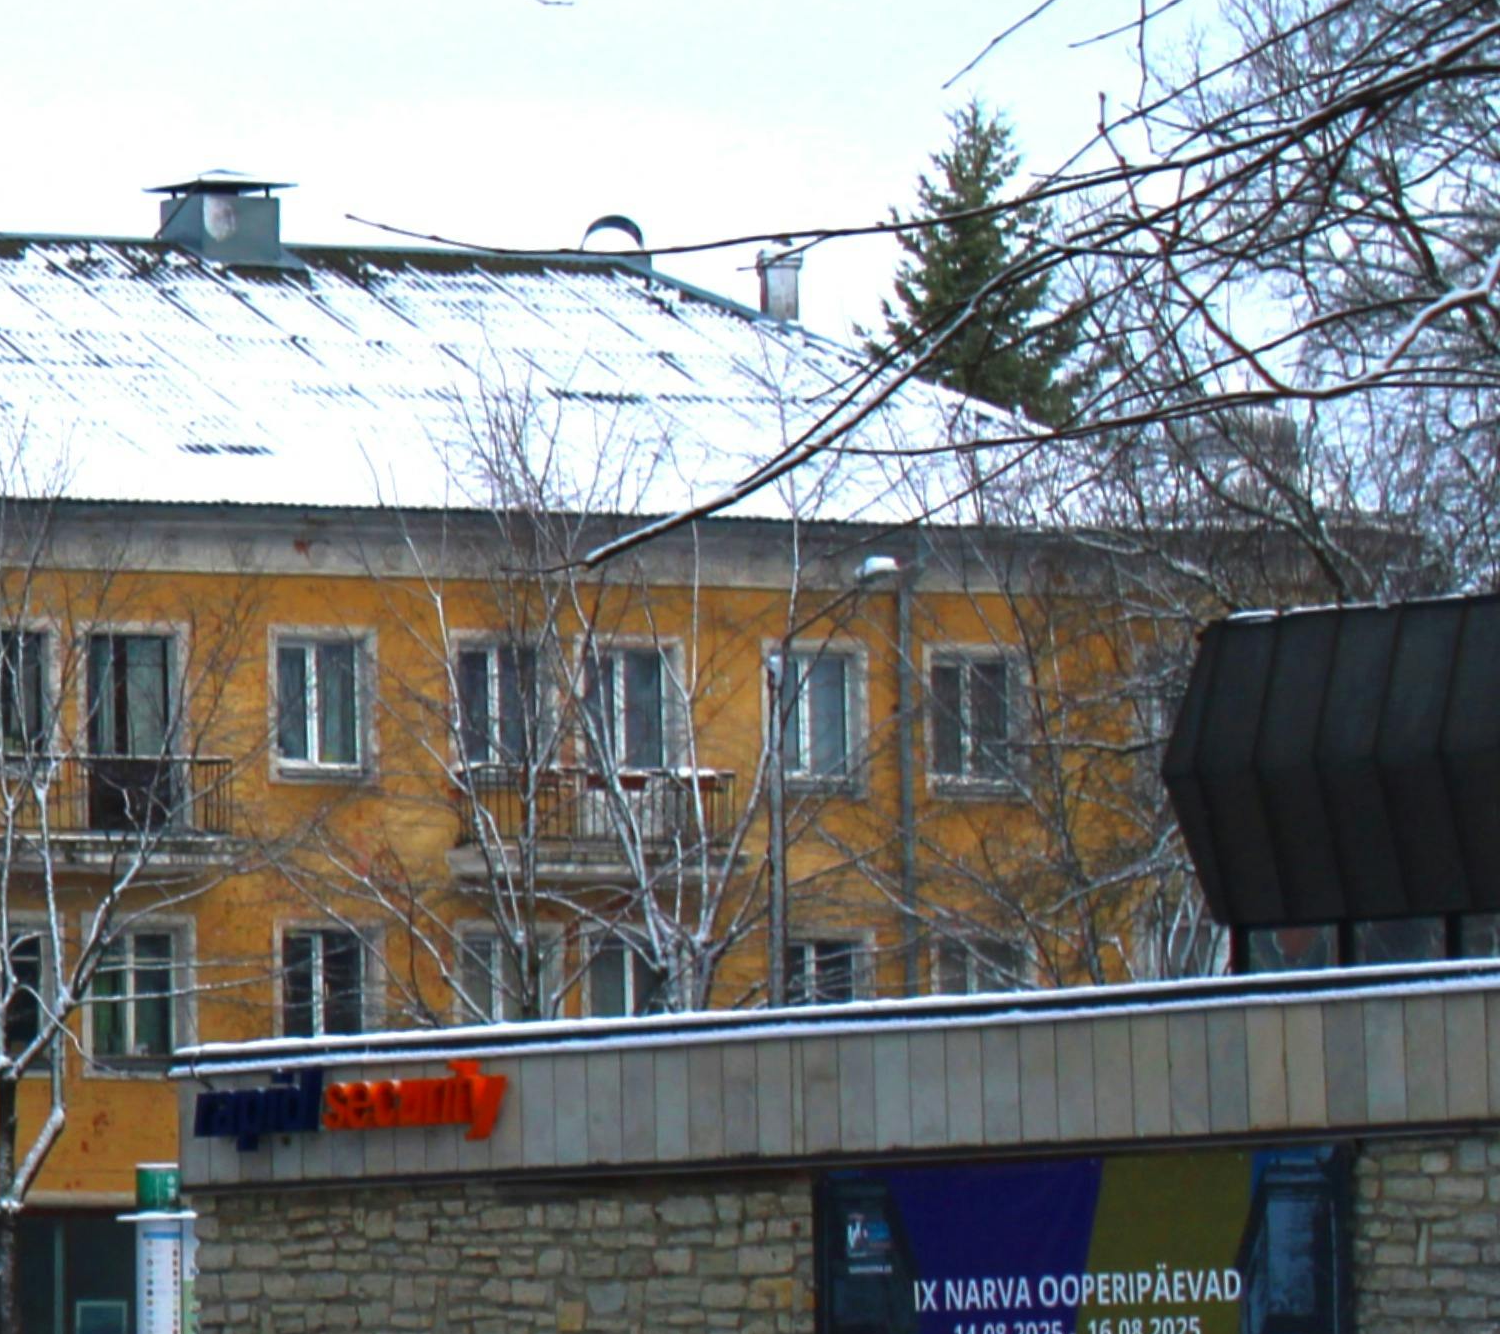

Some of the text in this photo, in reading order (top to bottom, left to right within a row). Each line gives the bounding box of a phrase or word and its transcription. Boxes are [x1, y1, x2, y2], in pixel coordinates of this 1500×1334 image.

[194, 1059, 507, 1152] rapid security
[913, 1263, 1242, 1312] IX NARVA OOPERIPÄEVAD
